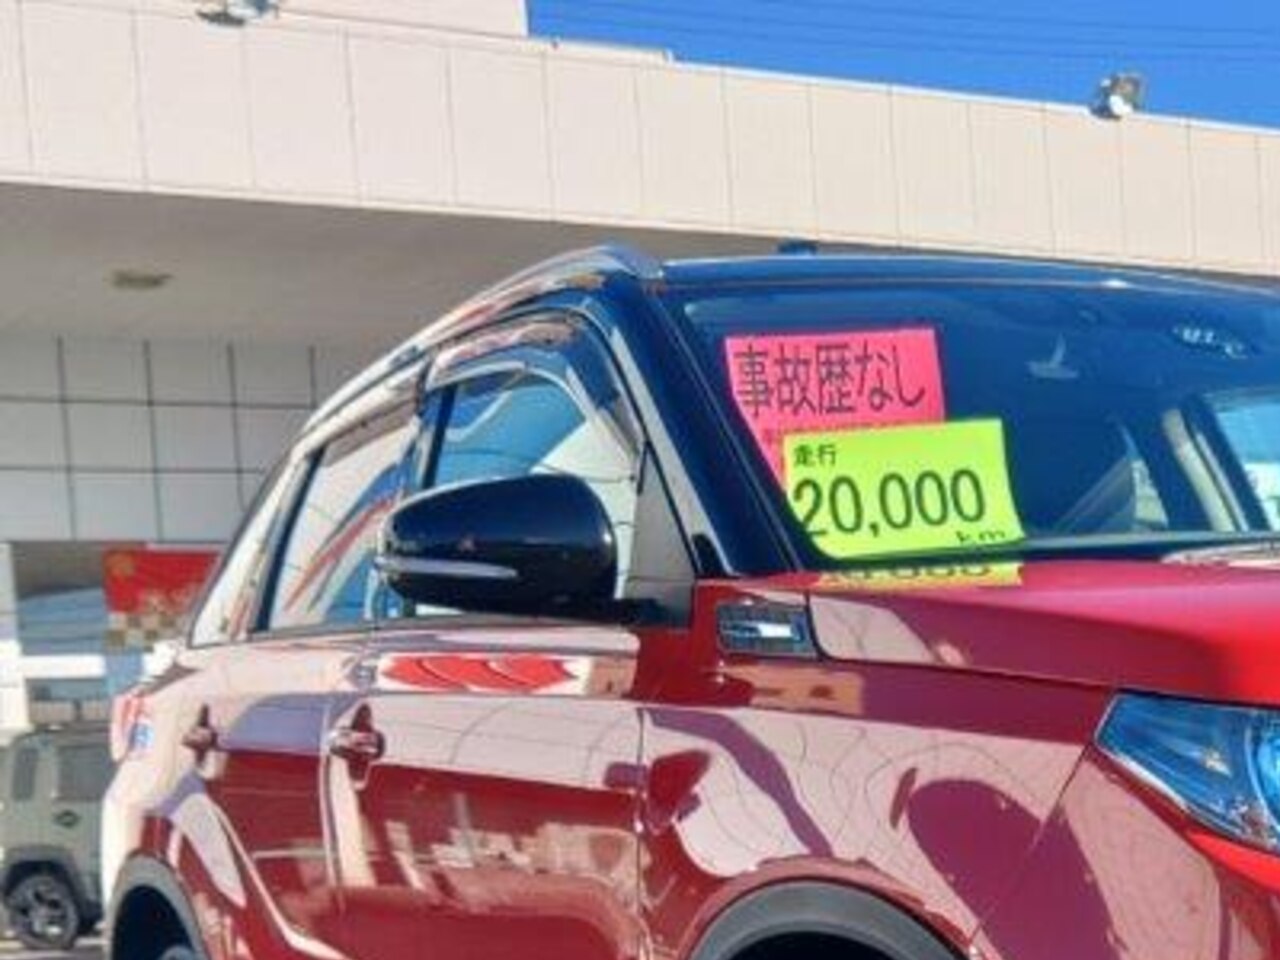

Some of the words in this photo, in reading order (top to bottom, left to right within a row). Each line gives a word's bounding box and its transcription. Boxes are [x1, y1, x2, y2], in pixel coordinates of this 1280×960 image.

[733, 340, 926, 416] 事故歴なし
[793, 444, 837, 468] 走行
[793, 468, 986, 538] 20,000
